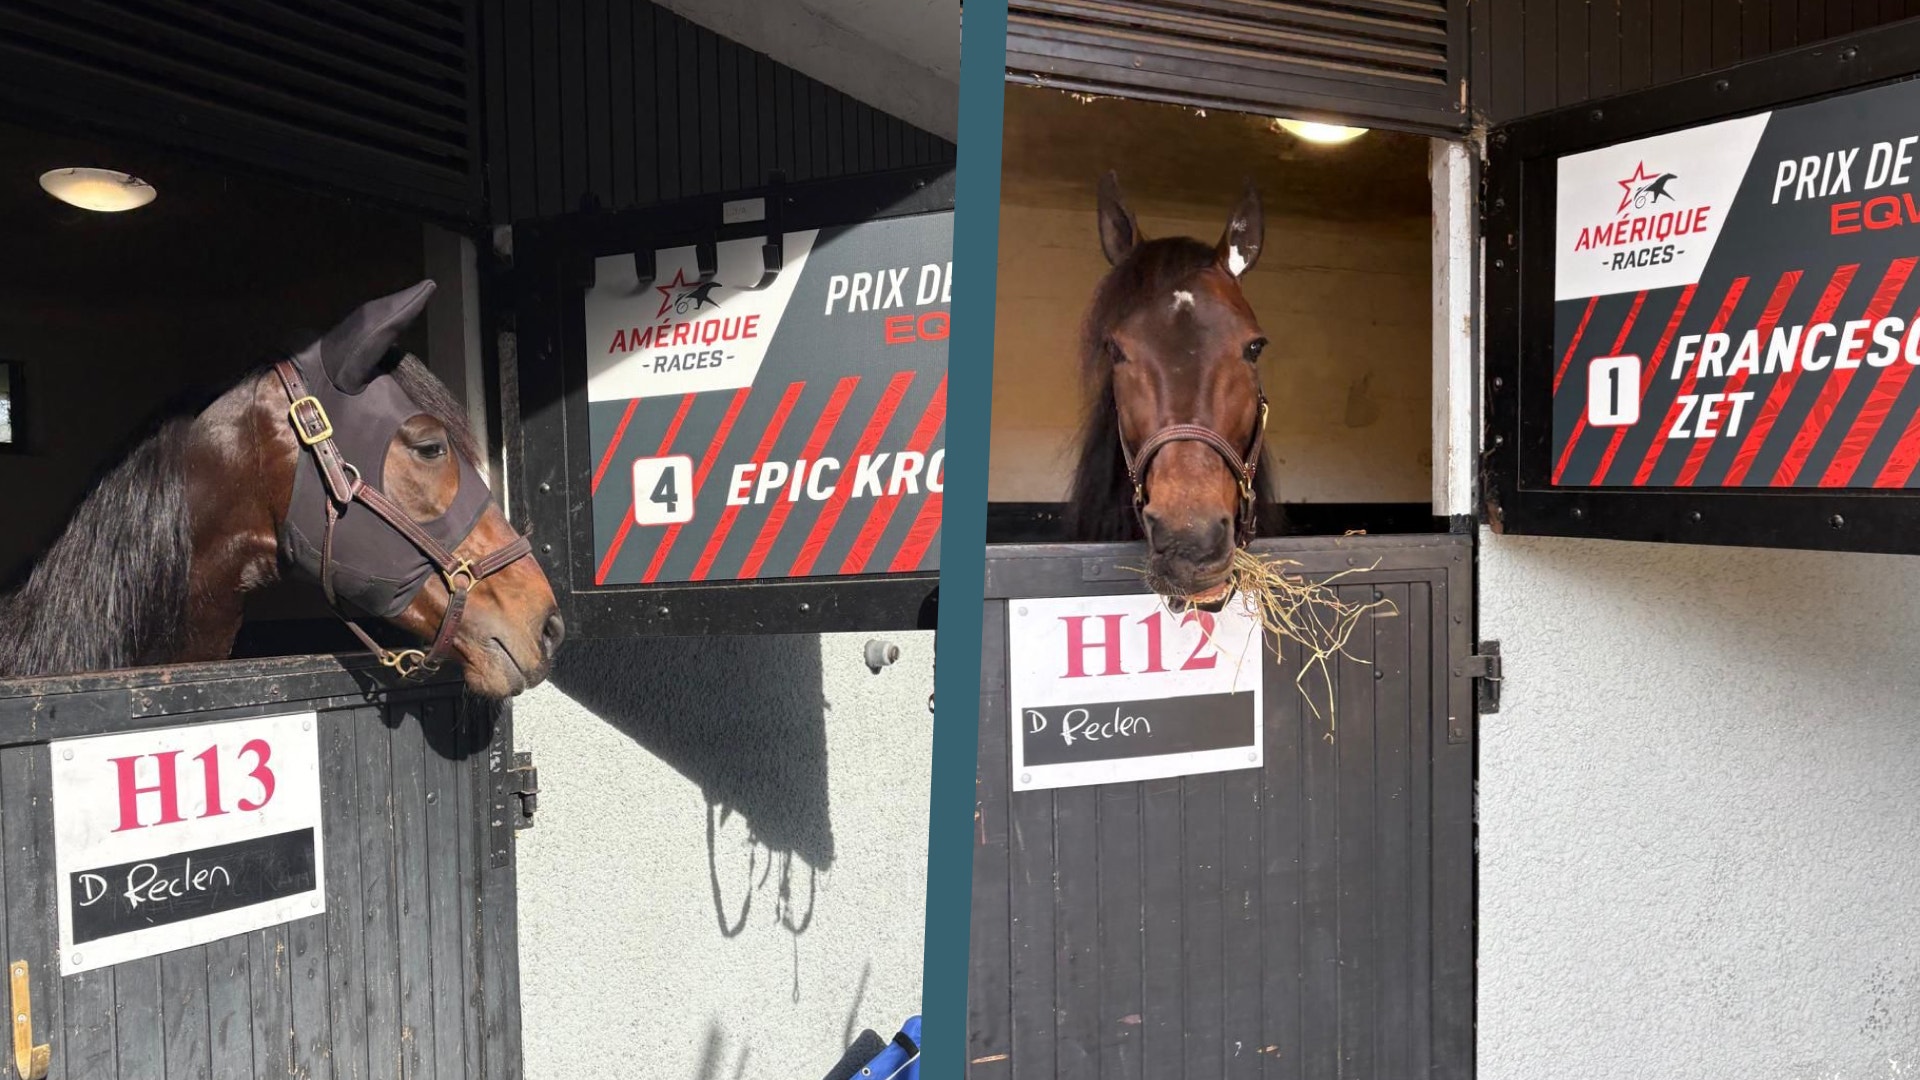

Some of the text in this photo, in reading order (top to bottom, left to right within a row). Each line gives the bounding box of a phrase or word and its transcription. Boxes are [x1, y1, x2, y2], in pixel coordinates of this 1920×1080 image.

[1771, 135, 1919, 204] PRIX DE
[1574, 206, 1711, 252] AMÉRIQUE
[824, 266, 910, 316] PRIX
[608, 314, 761, 354] AMÉRIQUE
[1608, 366, 1620, 416] 1
[1667, 391, 1755, 439] ZET
[649, 466, 679, 513] 4
[726, 457, 841, 506] EPIC
[1057, 610, 1218, 679] H12
[1025, 709, 1048, 734] D
[106, 738, 276, 833] H13
[78, 873, 107, 906] D
